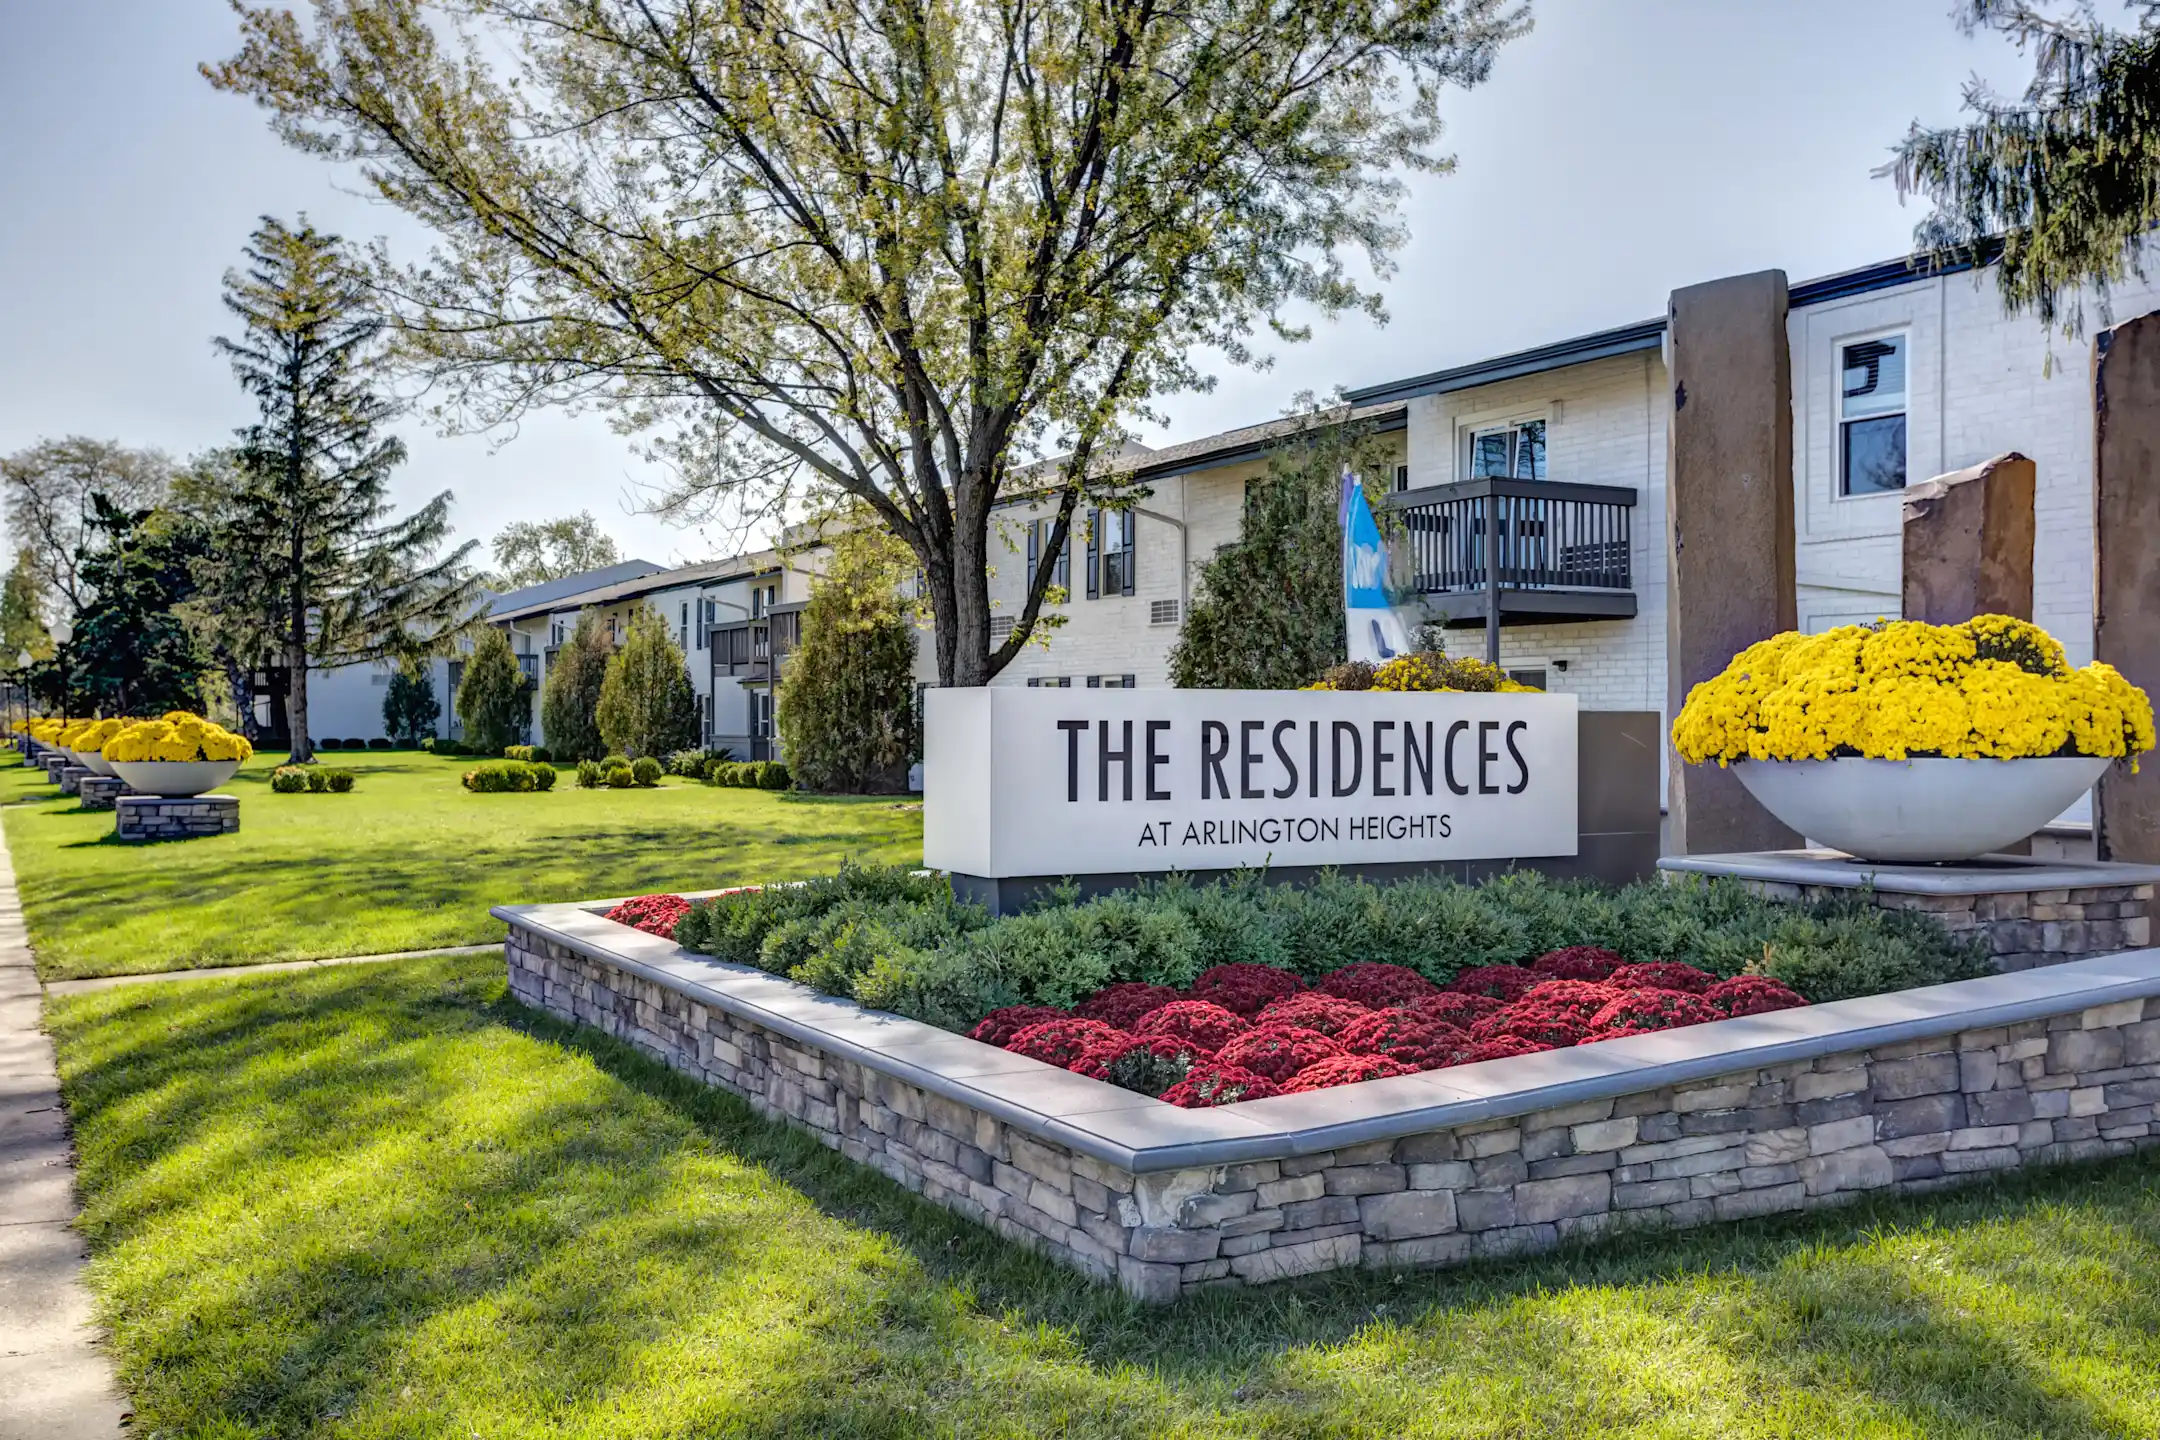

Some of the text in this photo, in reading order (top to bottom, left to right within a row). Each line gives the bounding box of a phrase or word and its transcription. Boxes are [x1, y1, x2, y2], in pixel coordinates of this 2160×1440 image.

[1056, 719, 1530, 803] THE RESIDENCES
[1138, 814, 1453, 847] AT ARLINGTON HEIGHTS
